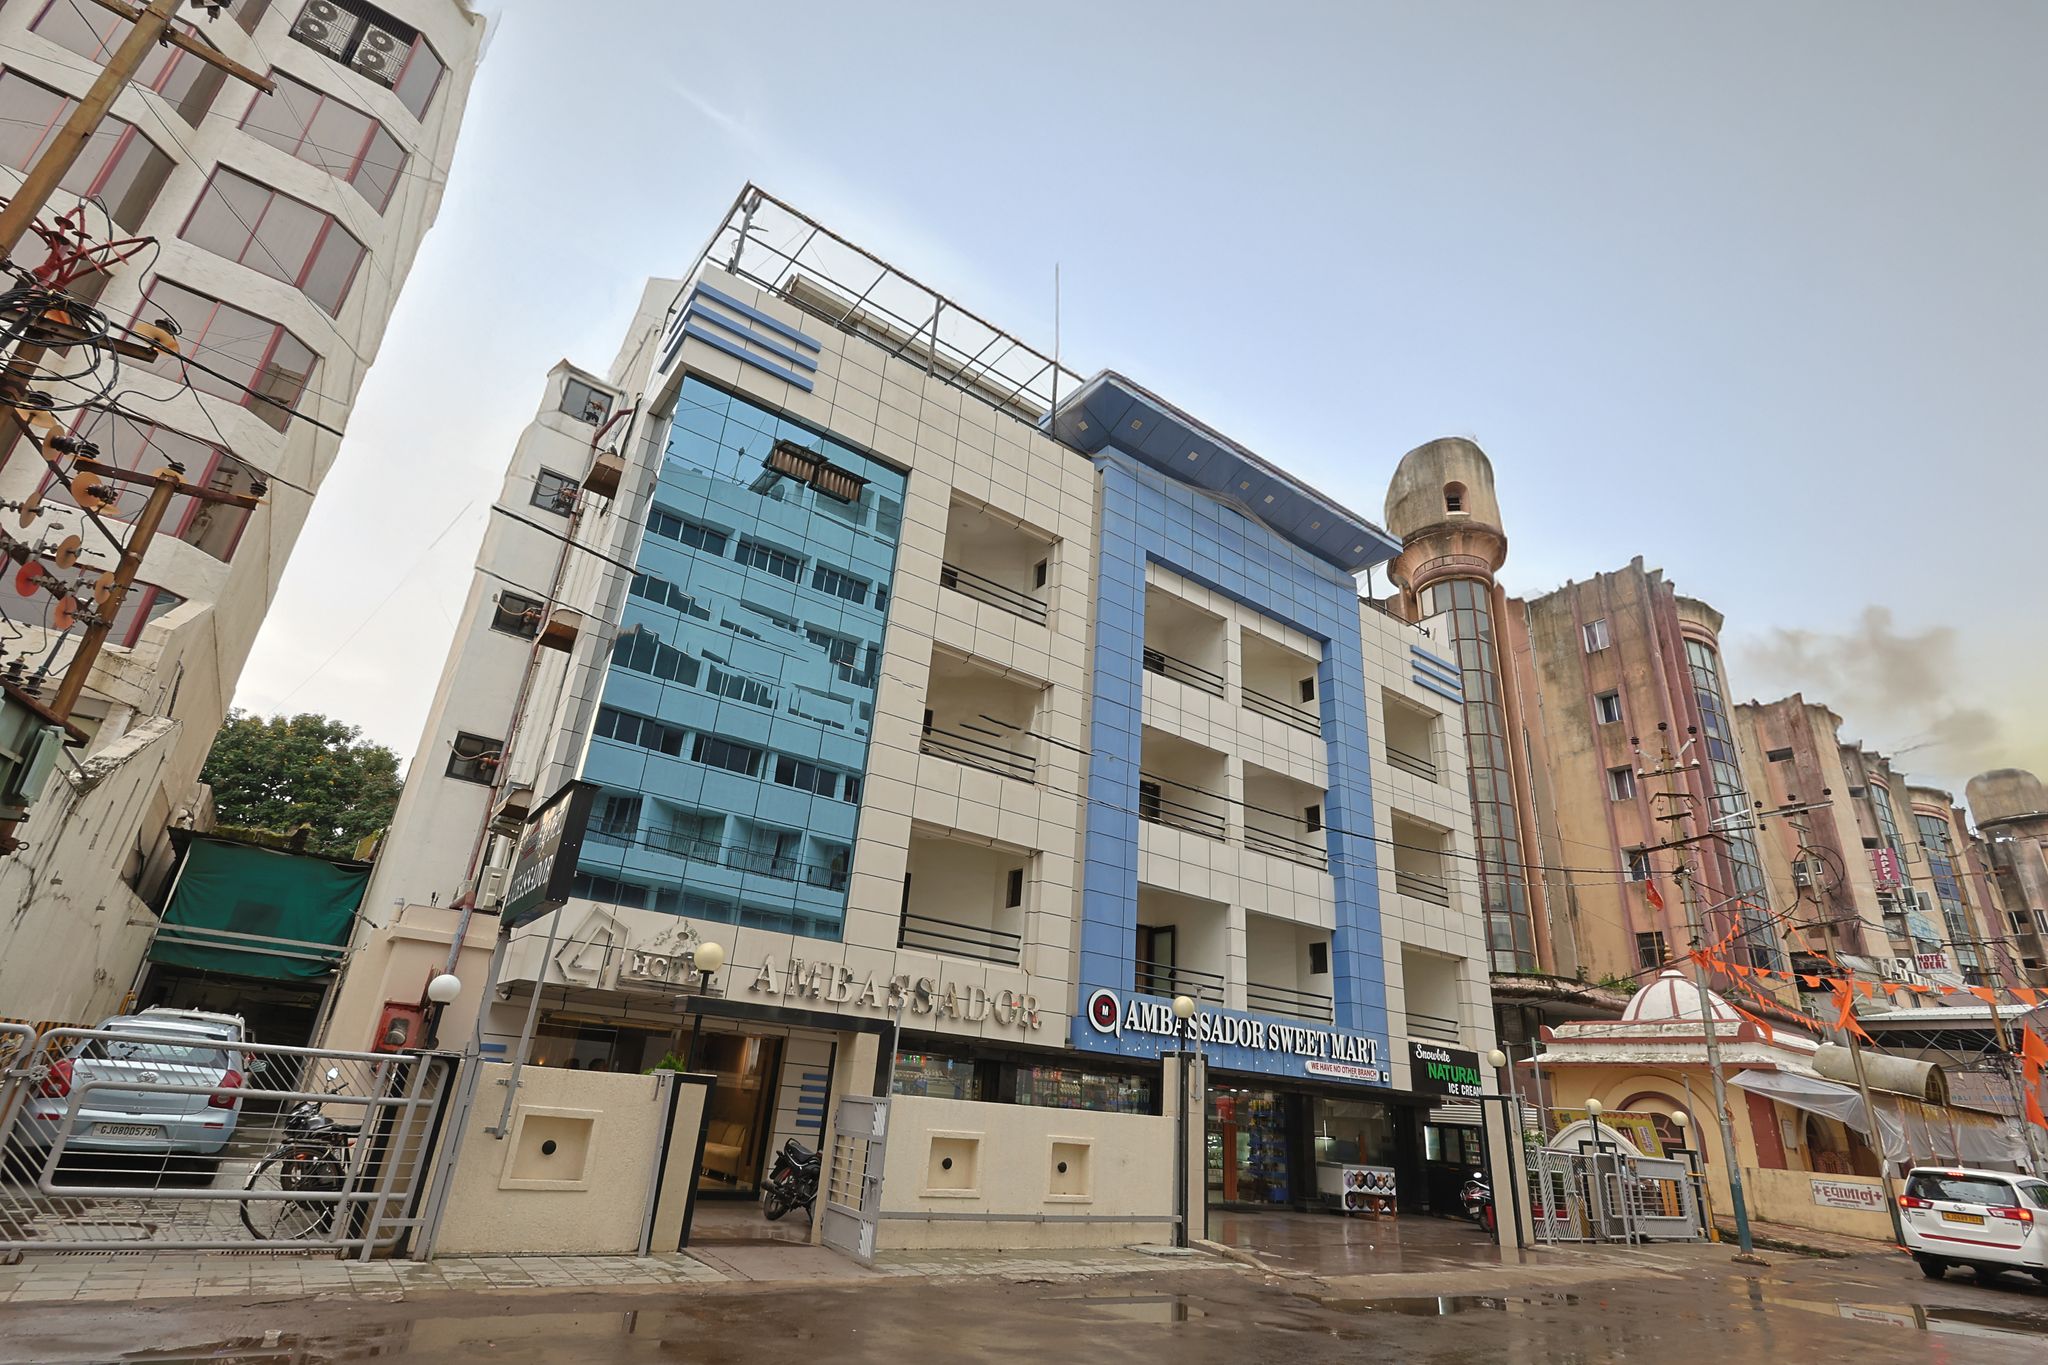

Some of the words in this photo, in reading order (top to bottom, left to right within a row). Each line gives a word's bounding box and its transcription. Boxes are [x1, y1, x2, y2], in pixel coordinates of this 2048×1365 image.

[1878, 848, 1891, 880] HAPPY
[1917, 953, 1946, 963] HOTEL
[1919, 961, 1948, 970] IDEAL
[748, 953, 1043, 1031] AMBASSADOR
[1268, 1023, 1328, 1058] SWEET
[1330, 1032, 1378, 1065] MART
[1311, 1061, 1319, 1070] WE
[1320, 1063, 1333, 1072] HAVE
[1333, 1064, 1341, 1073] NO
[1342, 1066, 1357, 1075] OTHER
[1358, 1068, 1377, 1077] BRANCH
[1427, 1061, 1481, 1085] NATURAL
[1448, 1082, 1459, 1095] ICE
[1461, 1083, 1483, 1097] CREAM
